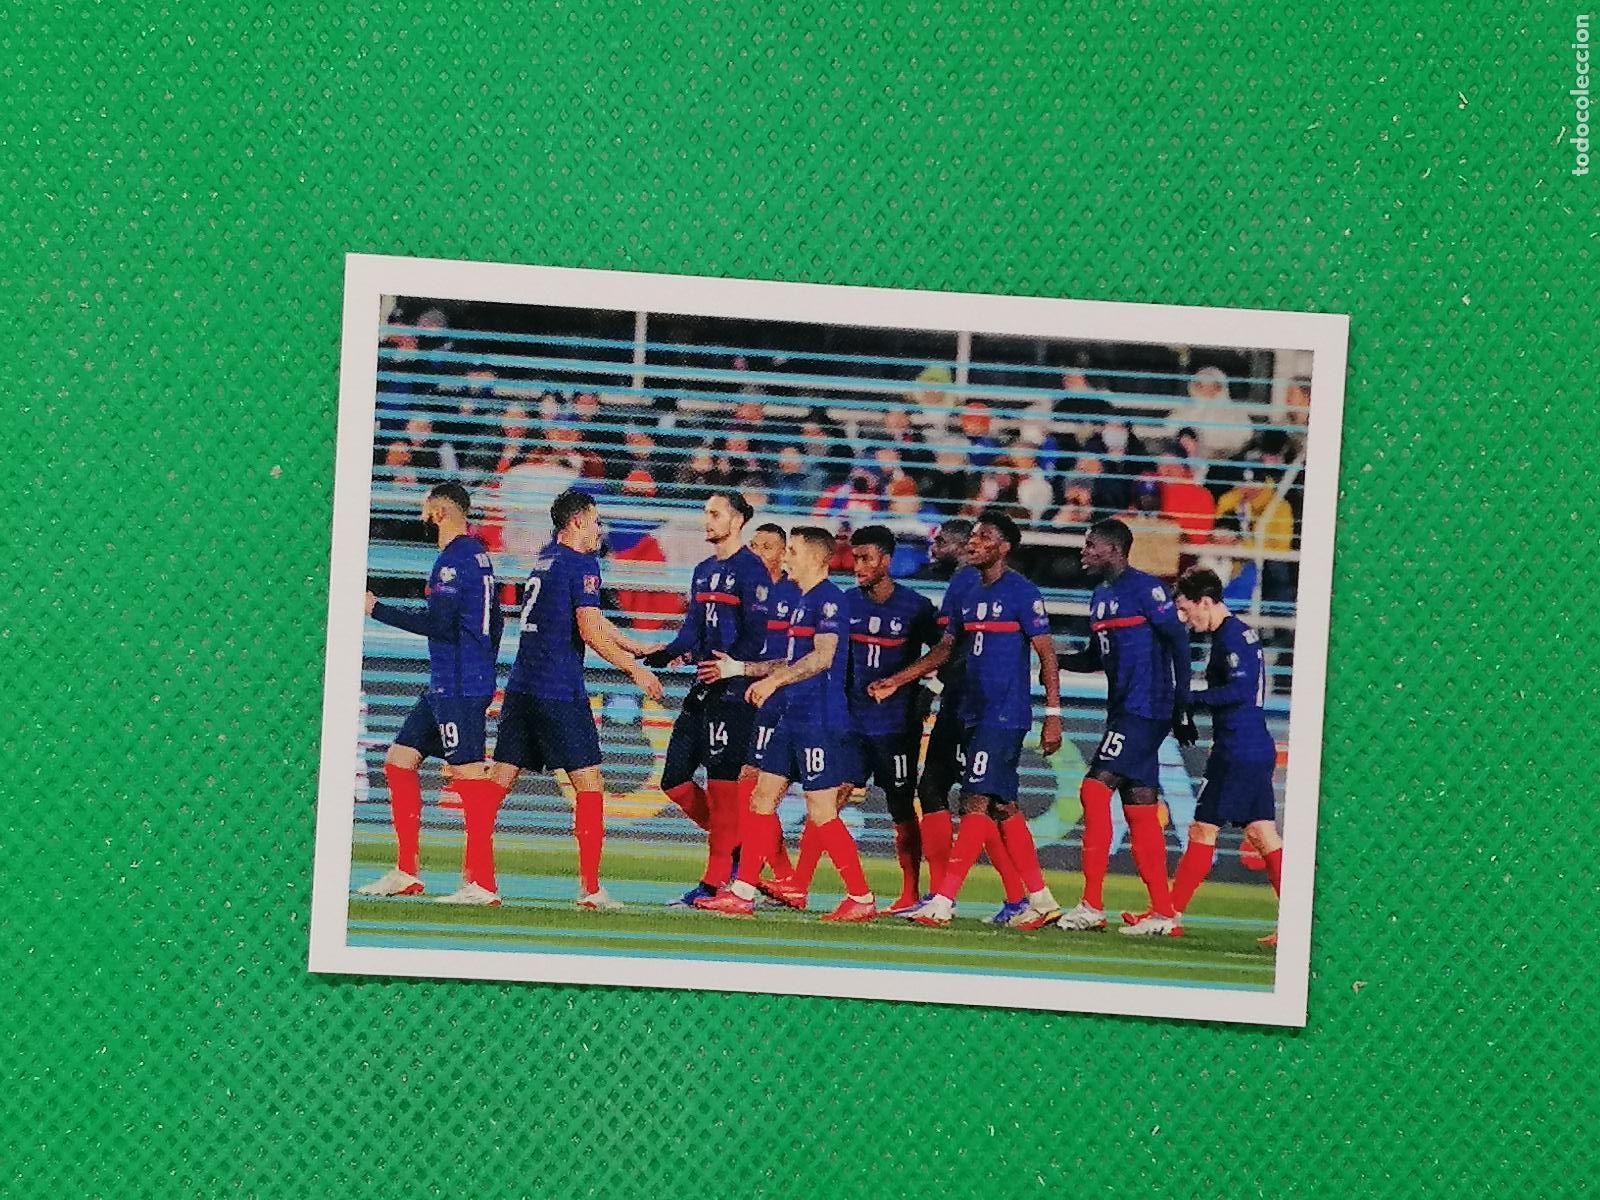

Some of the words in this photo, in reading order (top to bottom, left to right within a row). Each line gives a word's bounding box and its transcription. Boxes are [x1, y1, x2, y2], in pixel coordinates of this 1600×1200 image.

[867, 644, 880, 669] 11
[973, 631, 983, 657] 8
[439, 722, 460, 749] 19
[708, 722, 729, 747] 14
[1100, 731, 1125, 758] 15
[804, 747, 824, 773] 18
[893, 754, 907, 779] 11
[972, 750, 988, 776] 8
